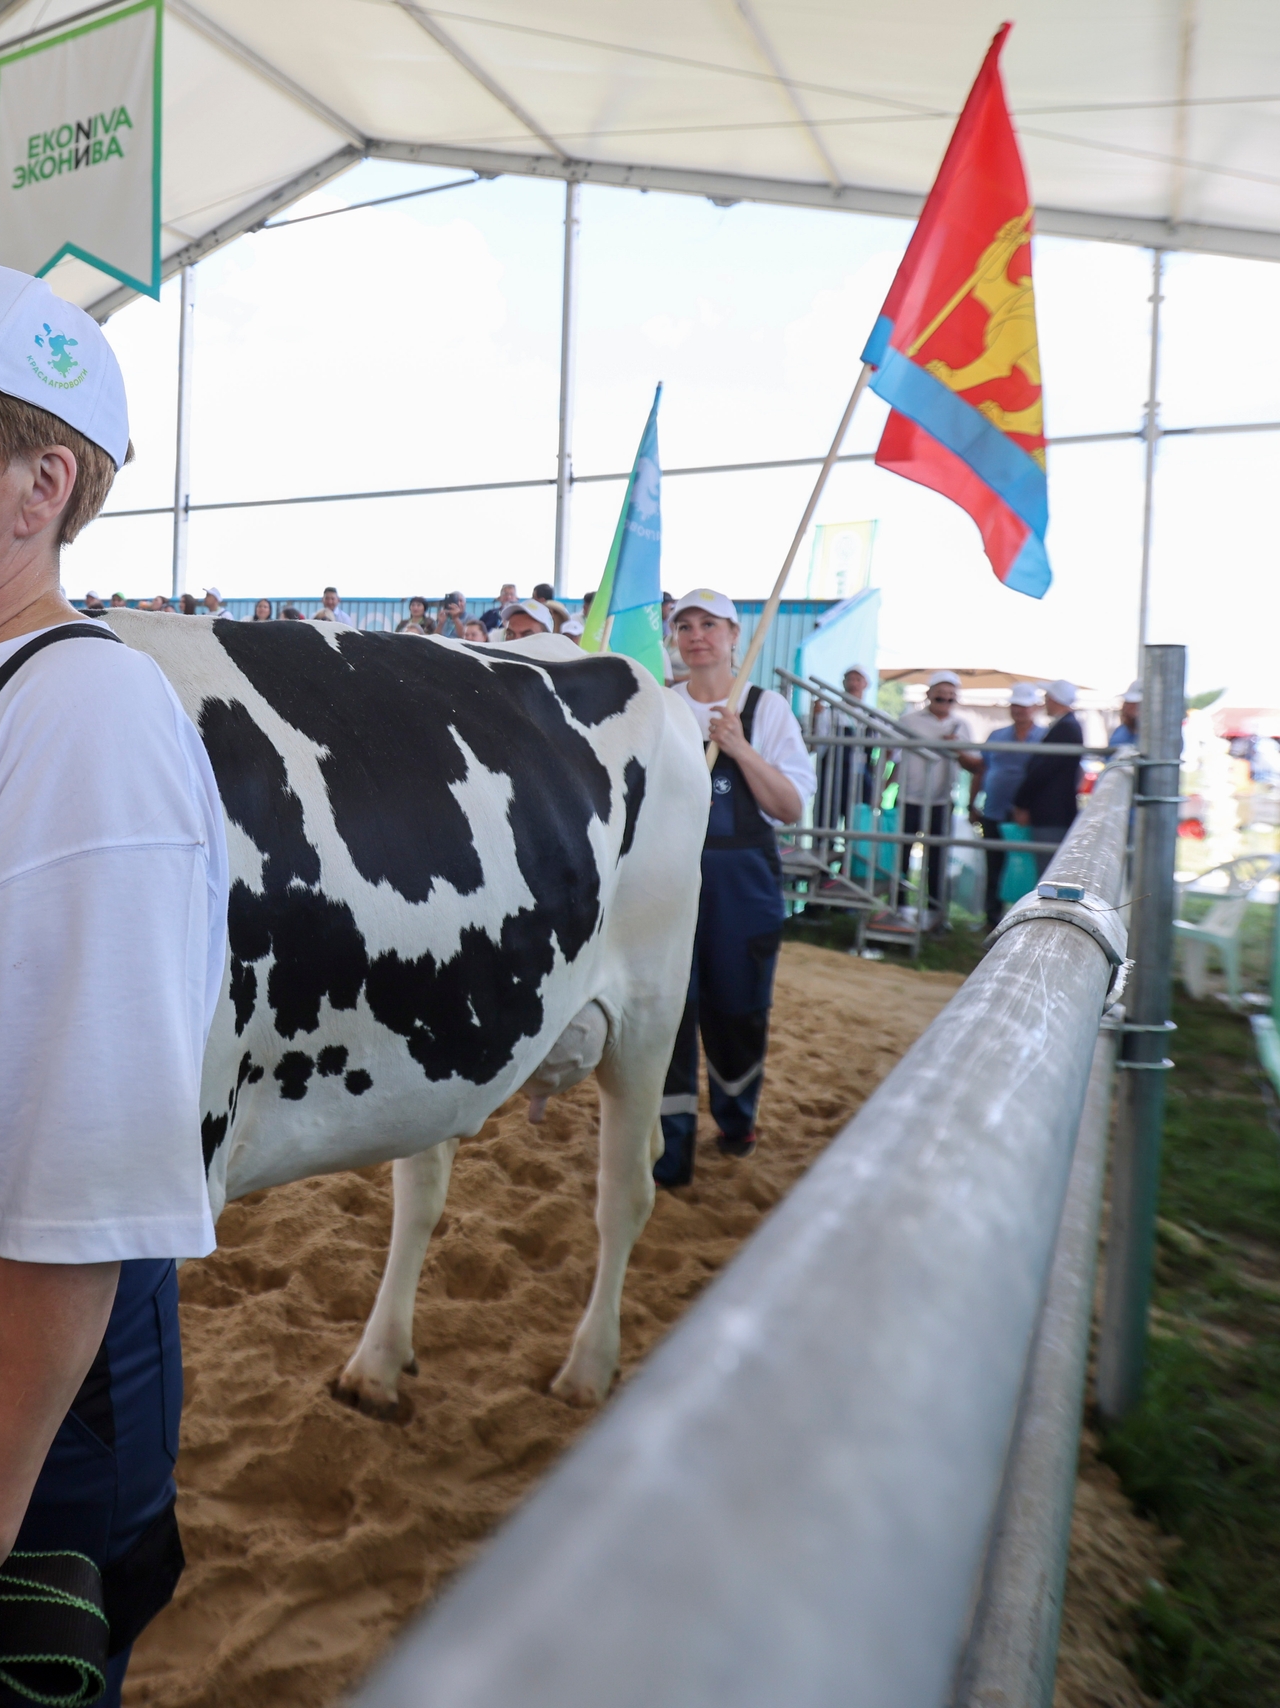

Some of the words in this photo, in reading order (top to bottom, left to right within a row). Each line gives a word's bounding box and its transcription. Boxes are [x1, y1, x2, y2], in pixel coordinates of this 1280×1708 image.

[27, 105, 133, 160] EKONIVA
[12, 136, 124, 189] ЭКОНИВА
[26, 355, 48, 384] КРАСА
[48, 368, 88, 389] АГРОВОЛГИ
